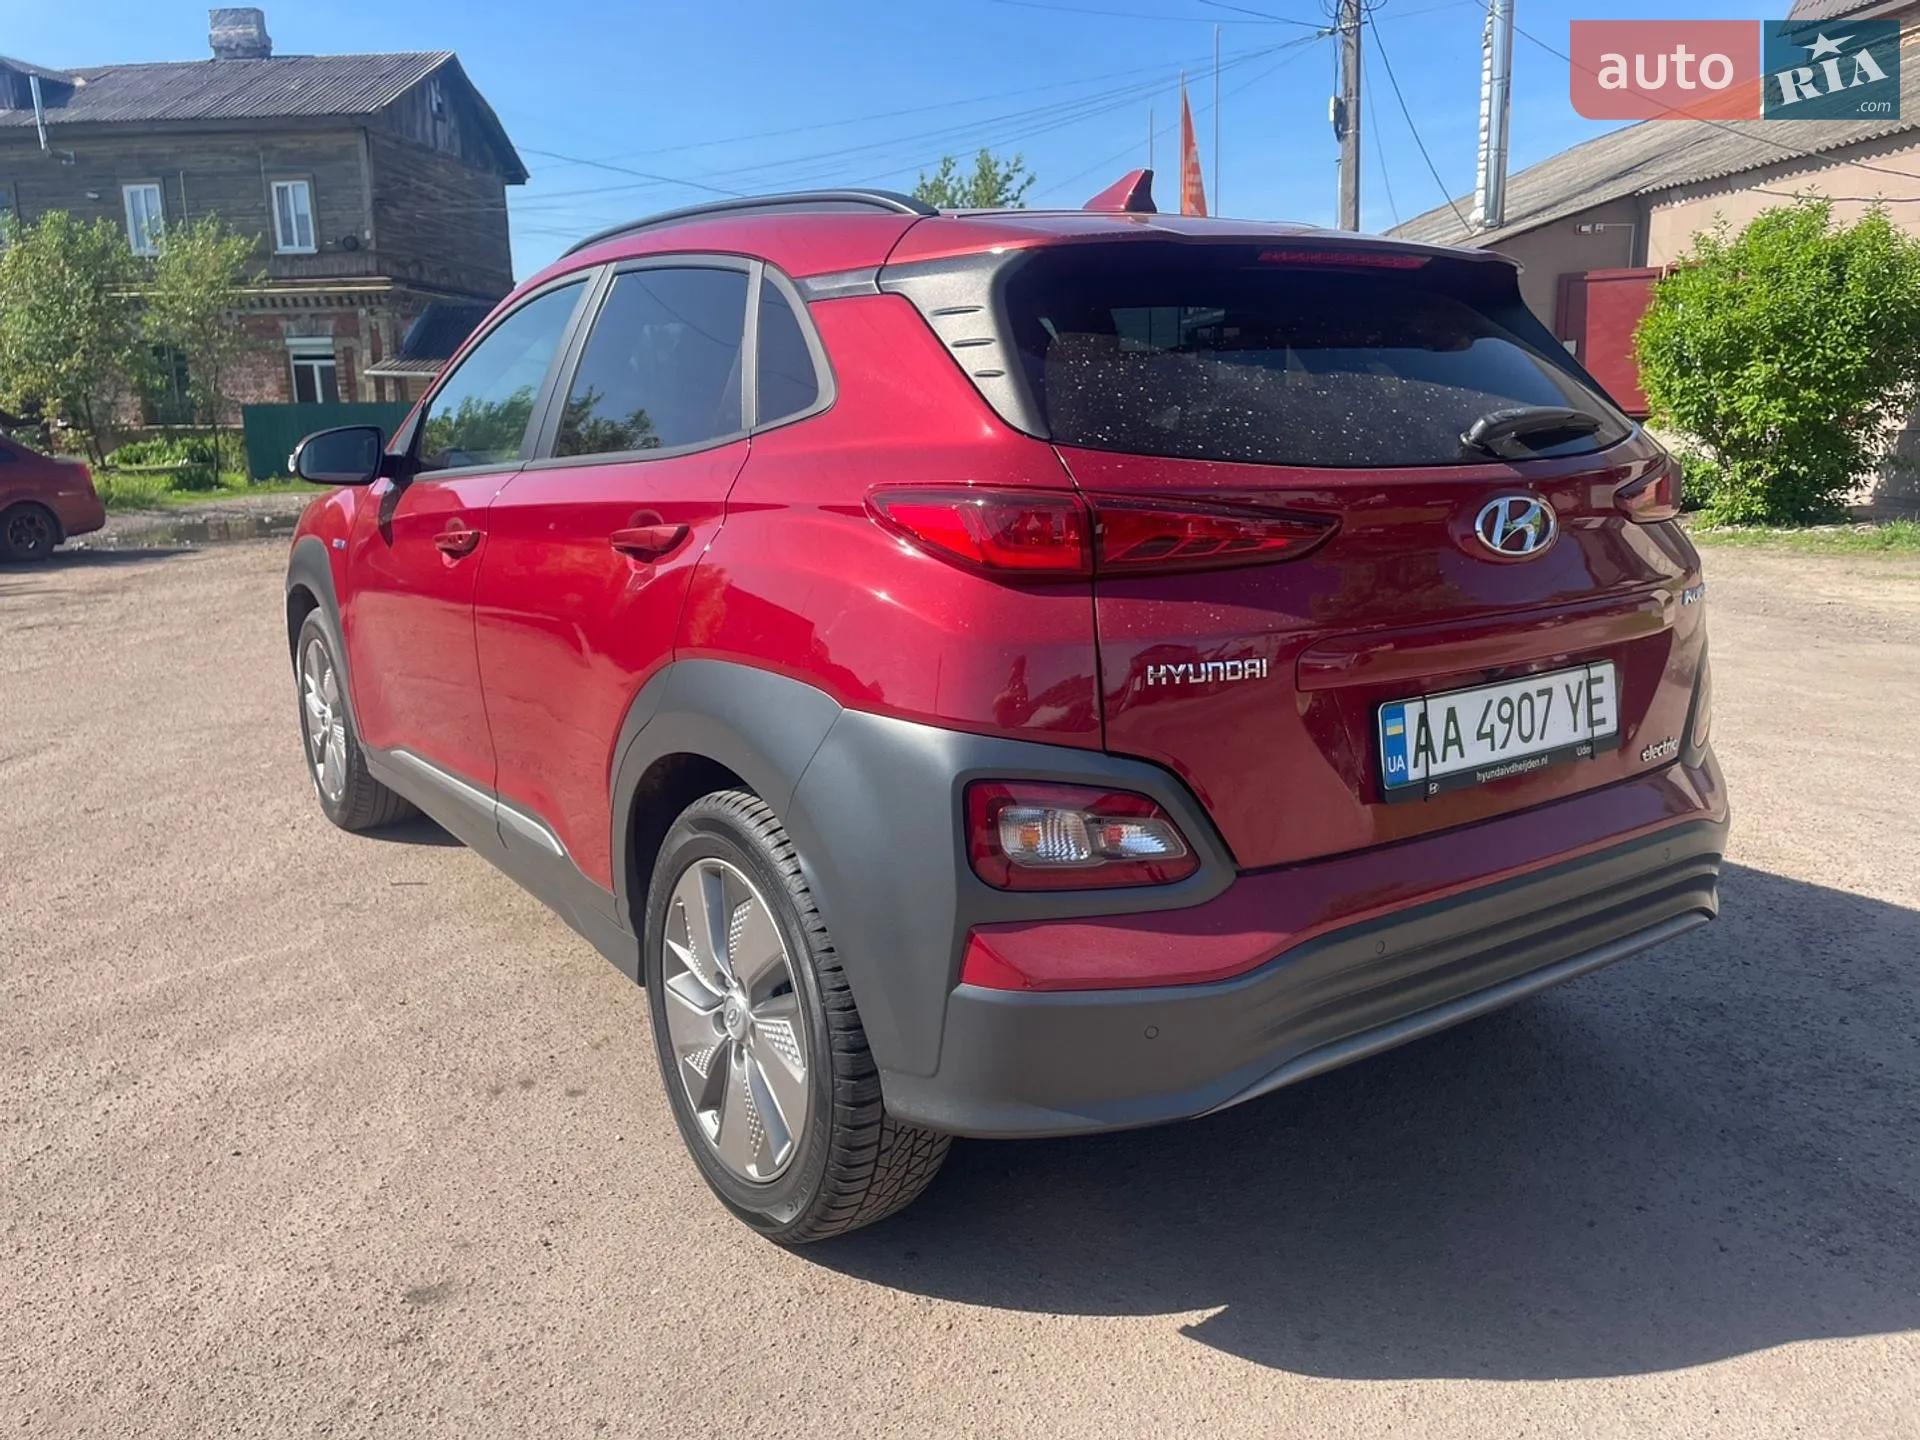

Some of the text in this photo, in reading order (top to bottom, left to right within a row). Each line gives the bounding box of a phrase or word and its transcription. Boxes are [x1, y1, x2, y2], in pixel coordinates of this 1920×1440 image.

[1147, 658, 1267, 685] HYUNDAI
[1413, 676, 1606, 768] AA 4907 YE
[1641, 736, 1678, 762] electric
[1387, 754, 1405, 773] UA
